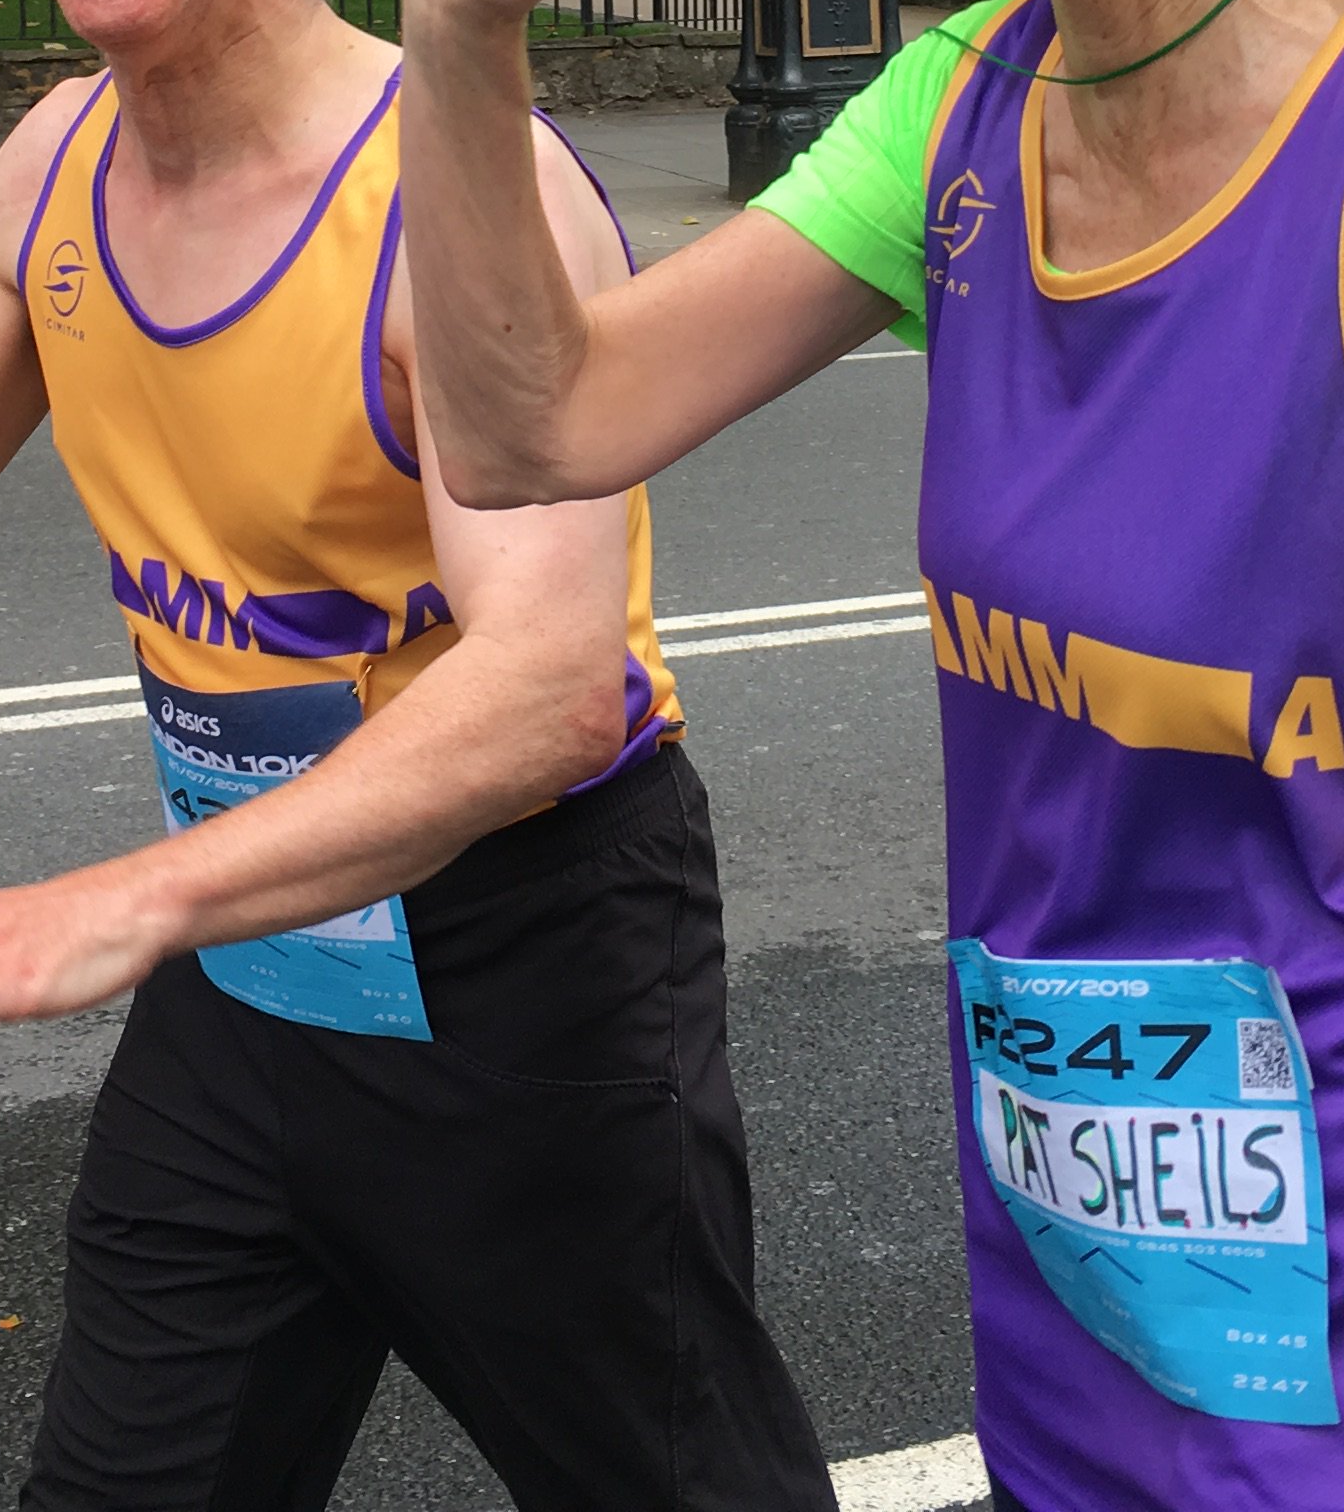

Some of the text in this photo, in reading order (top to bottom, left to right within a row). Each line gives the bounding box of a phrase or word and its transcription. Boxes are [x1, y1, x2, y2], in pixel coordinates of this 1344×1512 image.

[241, 753, 321, 777] 10K
[999, 1087, 1060, 1207] PAT
[1233, 1374, 1309, 1394] 2247
